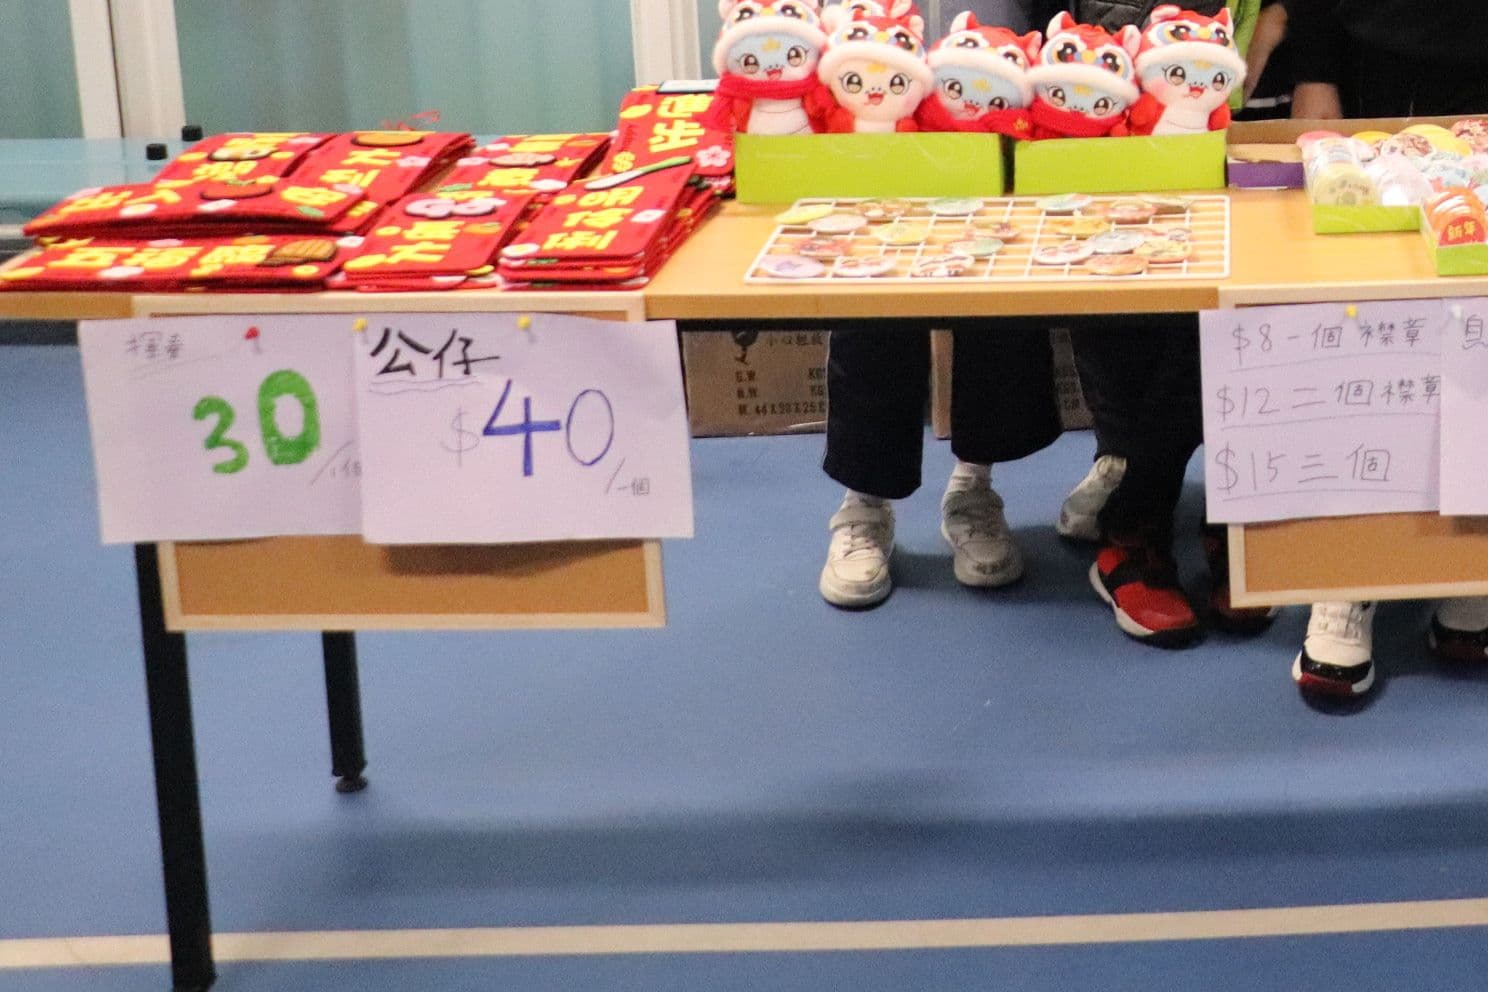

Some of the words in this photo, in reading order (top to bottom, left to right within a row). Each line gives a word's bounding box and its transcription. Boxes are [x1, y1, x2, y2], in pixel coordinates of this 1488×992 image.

[370, 328, 501, 379] 公仔
[193, 369, 321, 475] 30
[440, 378, 615, 477] $40
[1216, 384, 1281, 422] $12
[1214, 442, 1287, 494] $15
